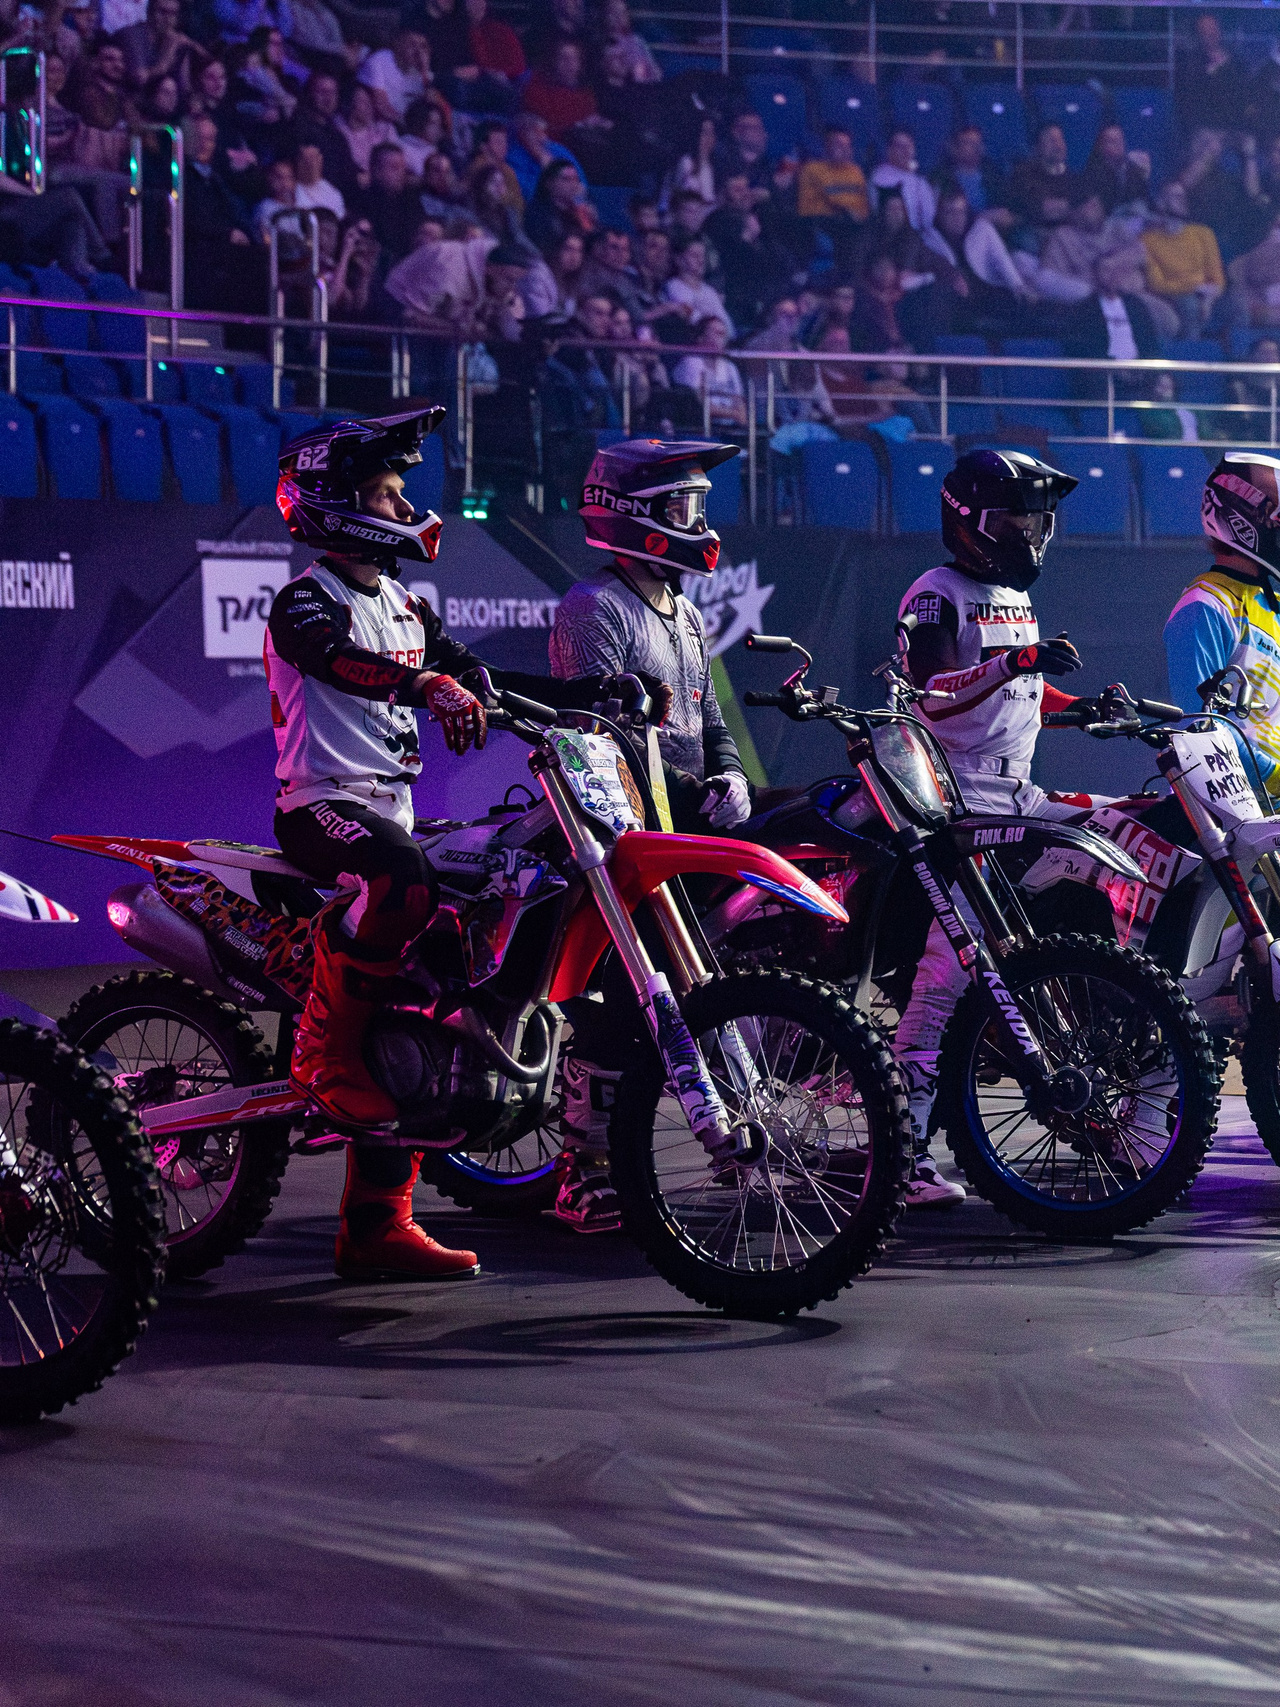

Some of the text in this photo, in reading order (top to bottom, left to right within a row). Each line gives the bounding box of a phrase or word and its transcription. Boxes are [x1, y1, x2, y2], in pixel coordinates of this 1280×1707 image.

[296, 444, 329, 471] 62
[341, 522, 404, 546] JUSTCAT
[973, 826, 1026, 846] FMX.RU
[912, 861, 965, 939] ВОЛЧИЙ ДУХ
[983, 971, 1040, 1055] KENDA
